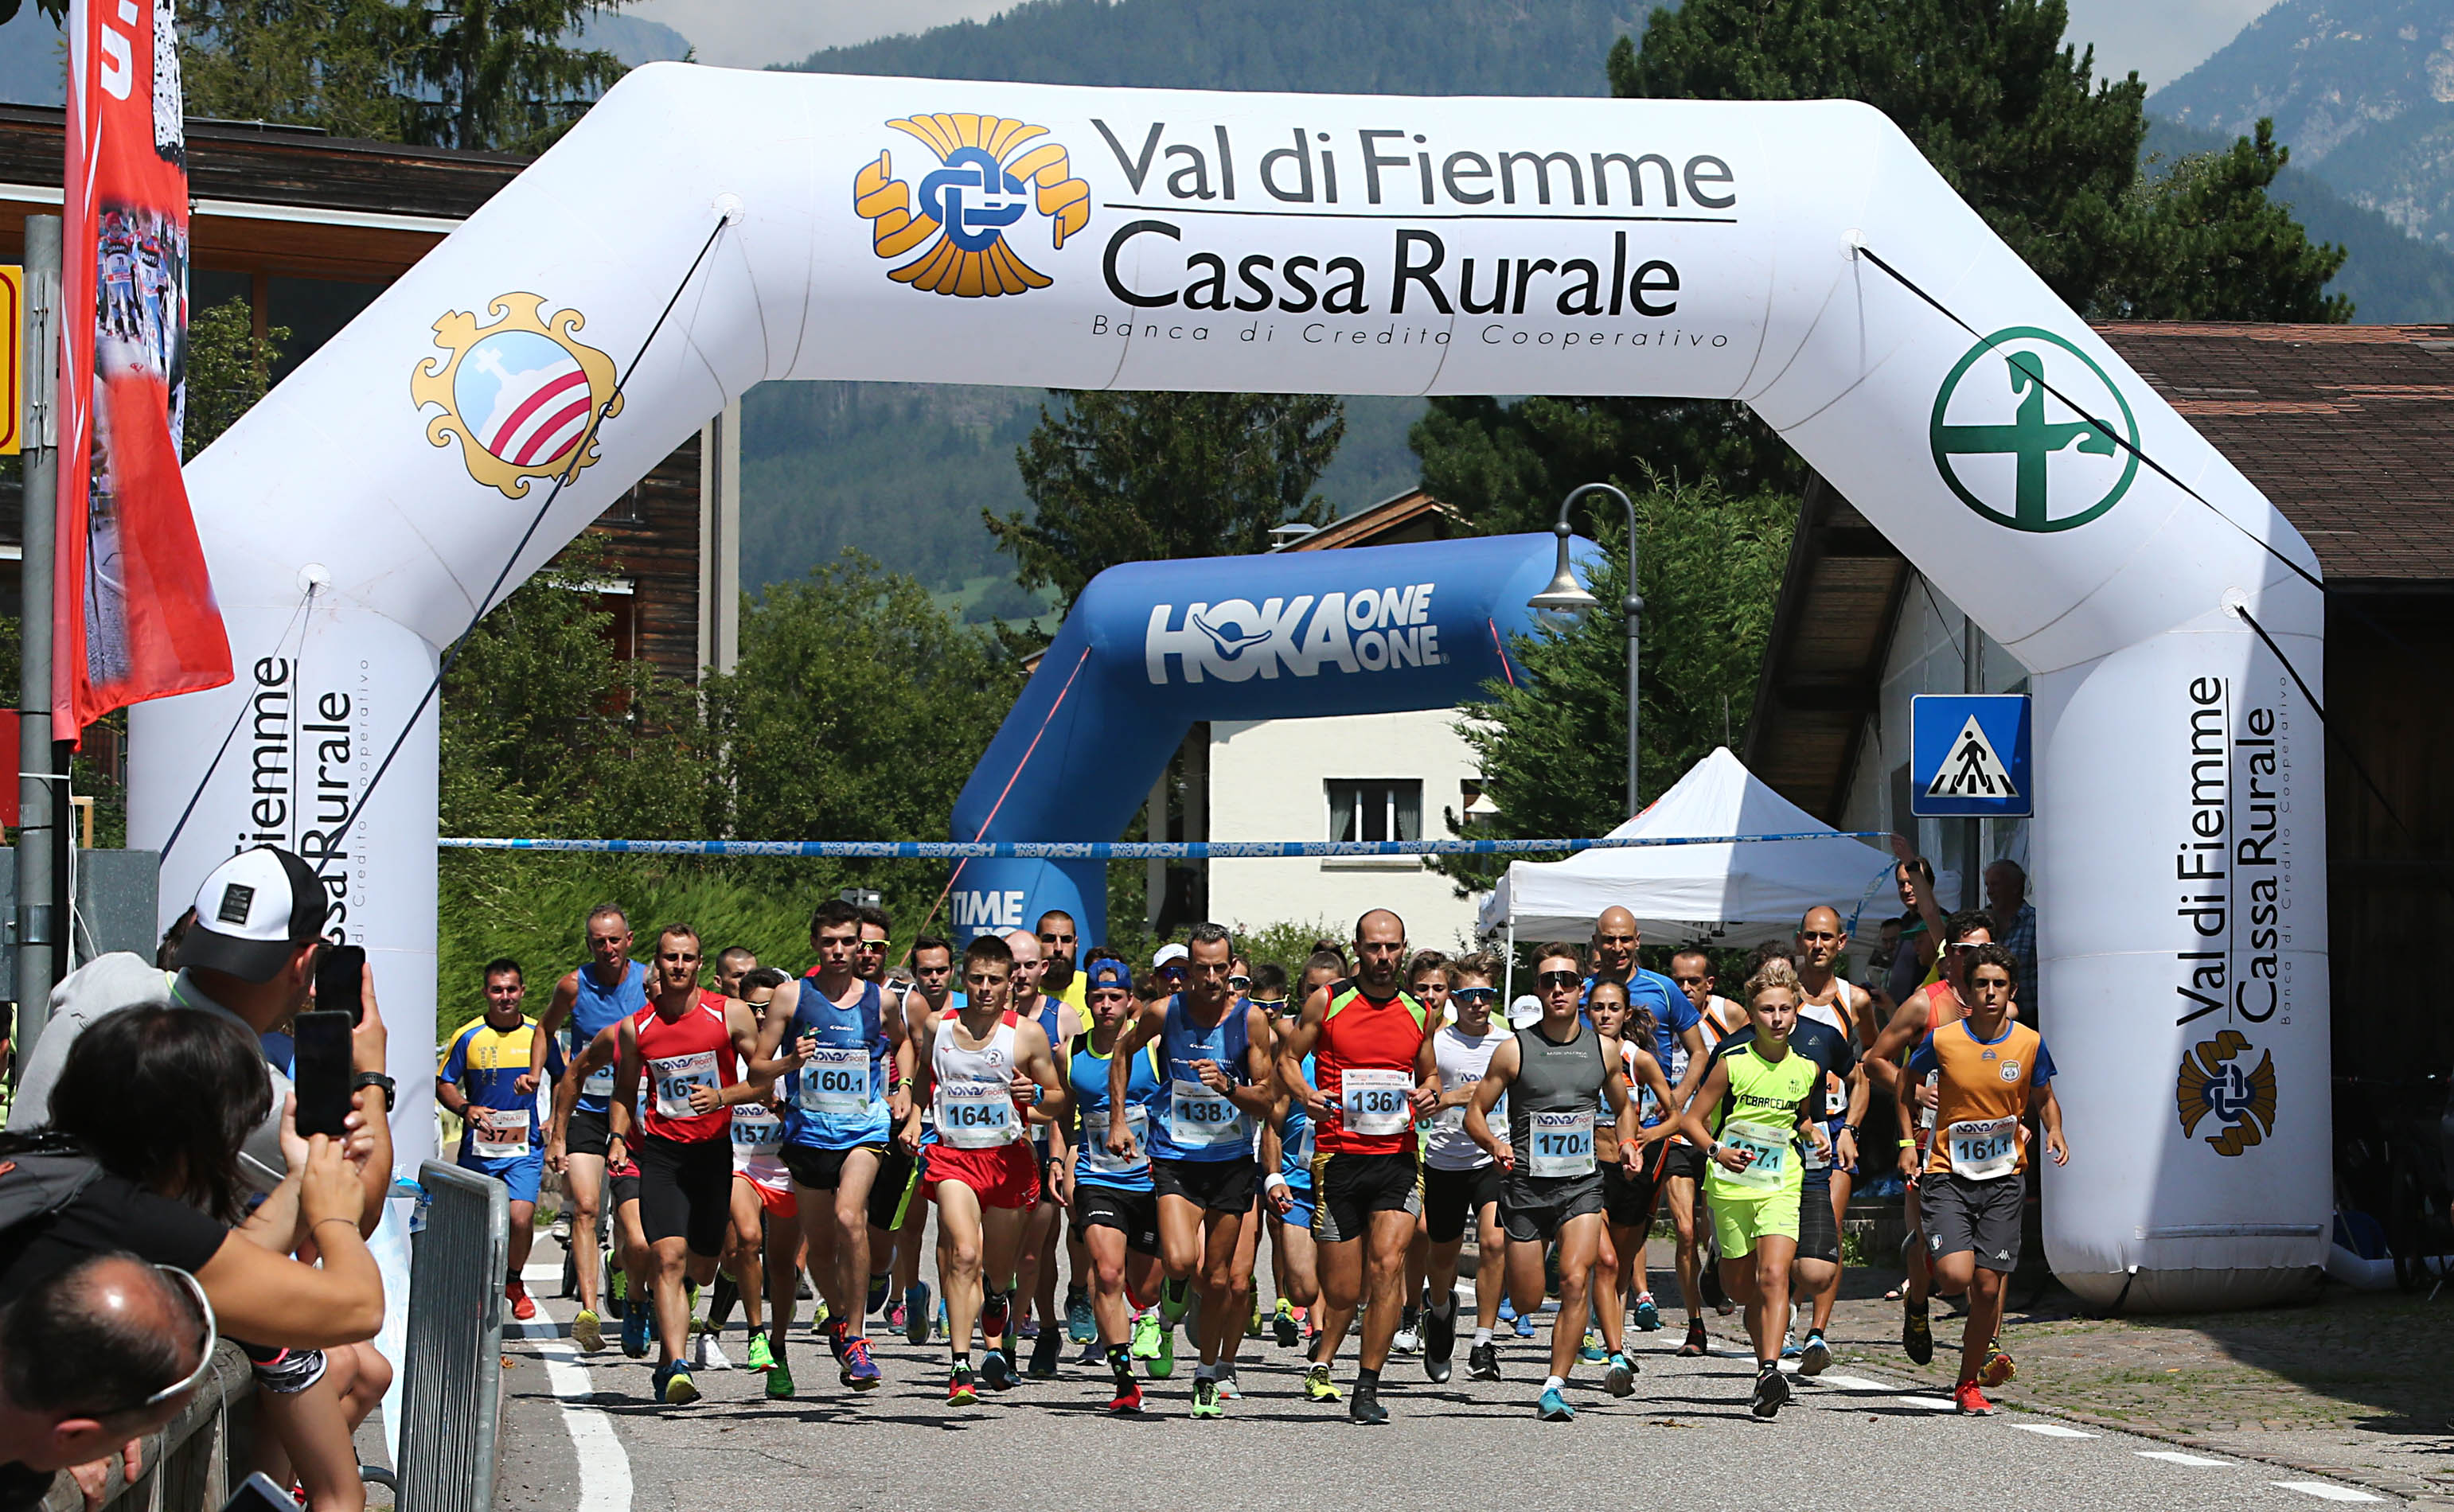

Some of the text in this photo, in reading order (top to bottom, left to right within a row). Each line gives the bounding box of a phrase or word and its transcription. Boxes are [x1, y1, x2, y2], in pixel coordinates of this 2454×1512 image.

[1090, 119, 1736, 208] Val di Fiemme
[1102, 220, 1680, 317] Cassa Rurale
[1092, 315, 1728, 351] Banca di Credito Cooperativo
[1145, 583, 1440, 684] HOKA ONE ONE
[236, 657, 288, 855] iemme
[355, 659, 372, 803] Cooperativo
[301, 692, 350, 946] ssa Rurale
[2176, 676, 2226, 1027] Val di Fiemme
[2280, 676, 2292, 1025] Banca di Credito Cooperativo
[353, 820, 367, 907] Credito
[2235, 707, 2278, 1023] Cassa Rurale
[952, 890, 1024, 926] TIME
[808, 1070, 863, 1092] 160.1
[950, 1106, 1005, 1126] 164.1
[1180, 1102, 1233, 1122] 138.1
[1352, 1091, 1406, 1113] 136.1
[1539, 1134, 1589, 1155] 170.1
[1959, 1139, 2008, 1159] 161.1
